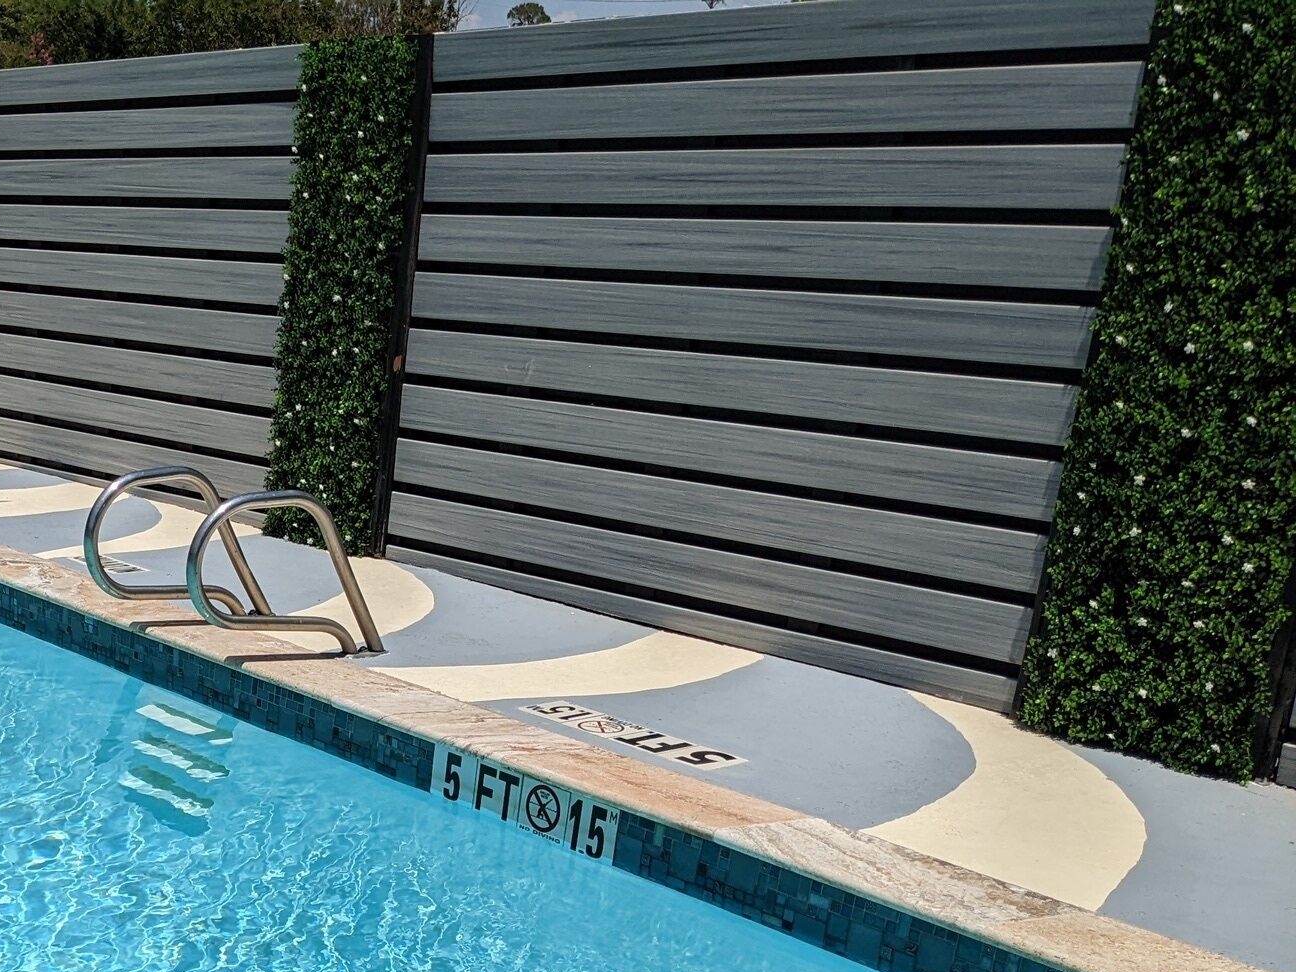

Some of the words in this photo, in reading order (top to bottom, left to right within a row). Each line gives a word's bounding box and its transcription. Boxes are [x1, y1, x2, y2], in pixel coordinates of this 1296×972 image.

[674, 750, 736, 766] 5
[443, 751, 462, 802] 5
[474, 763, 520, 822] FT
[519, 824, 531, 832] NO
[532, 829, 561, 845] DIVING
